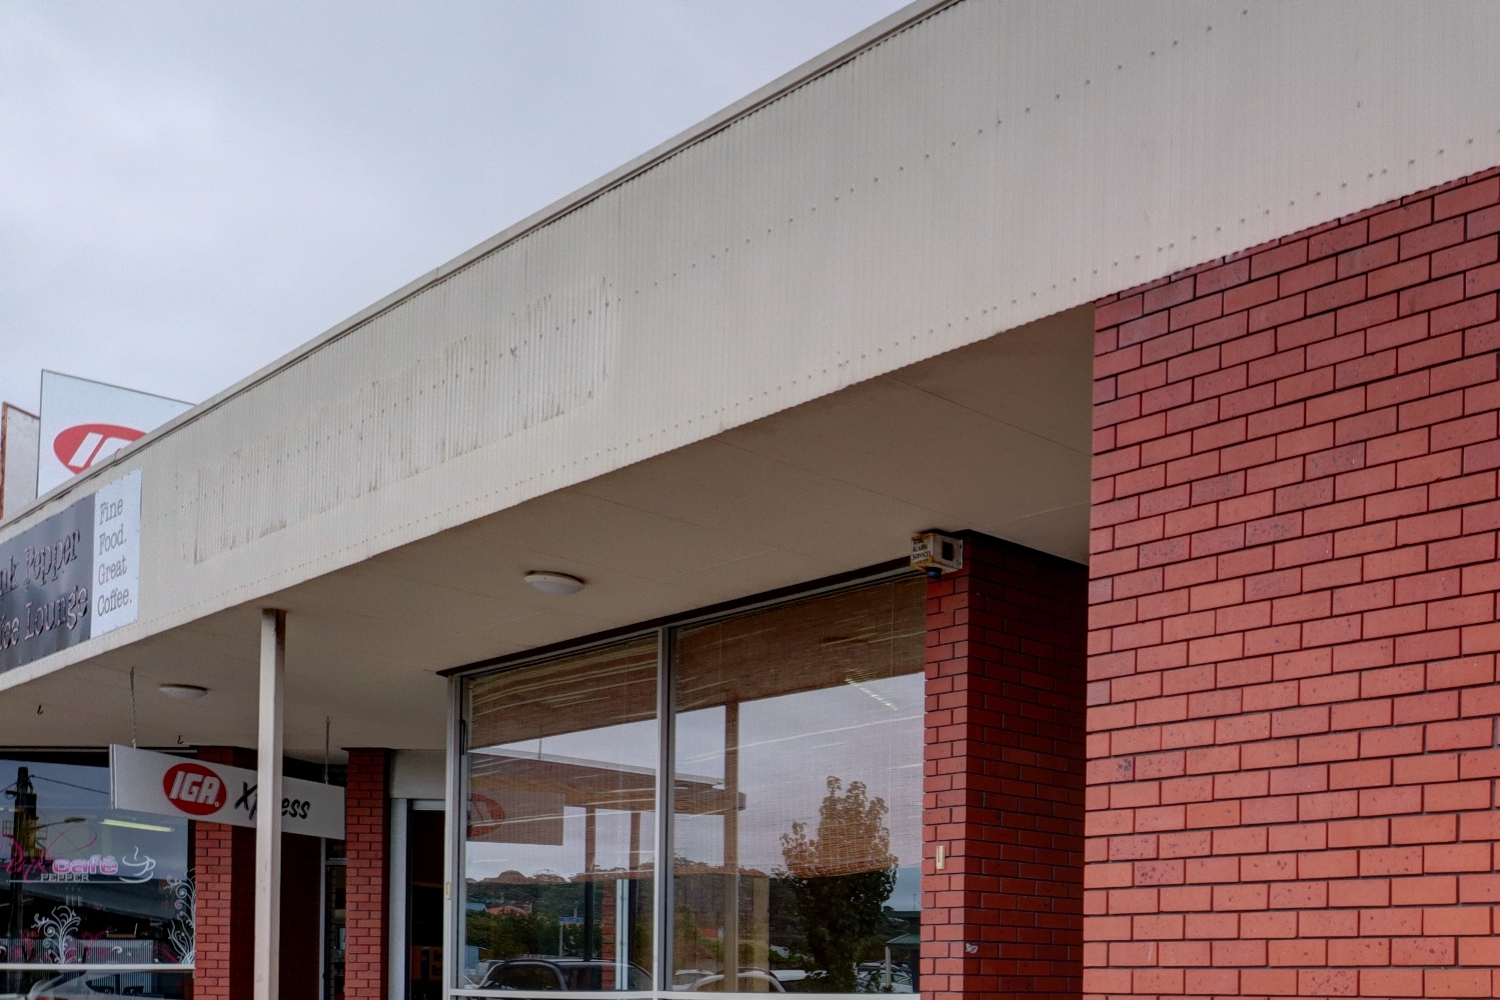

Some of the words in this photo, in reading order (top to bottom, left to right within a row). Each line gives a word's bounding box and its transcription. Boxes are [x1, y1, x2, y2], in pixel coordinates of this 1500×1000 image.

[99, 499, 124, 526] Fine
[98, 523, 128, 556] Food.
[24, 529, 81, 586] Pepper
[97, 554, 128, 587] Great
[24, 586, 89, 640] Lounge
[97, 588, 133, 617] Coffee.
[169, 771, 220, 806] IGA
[40, 873, 90, 882] PEPPER
[52, 854, 119, 875] café
